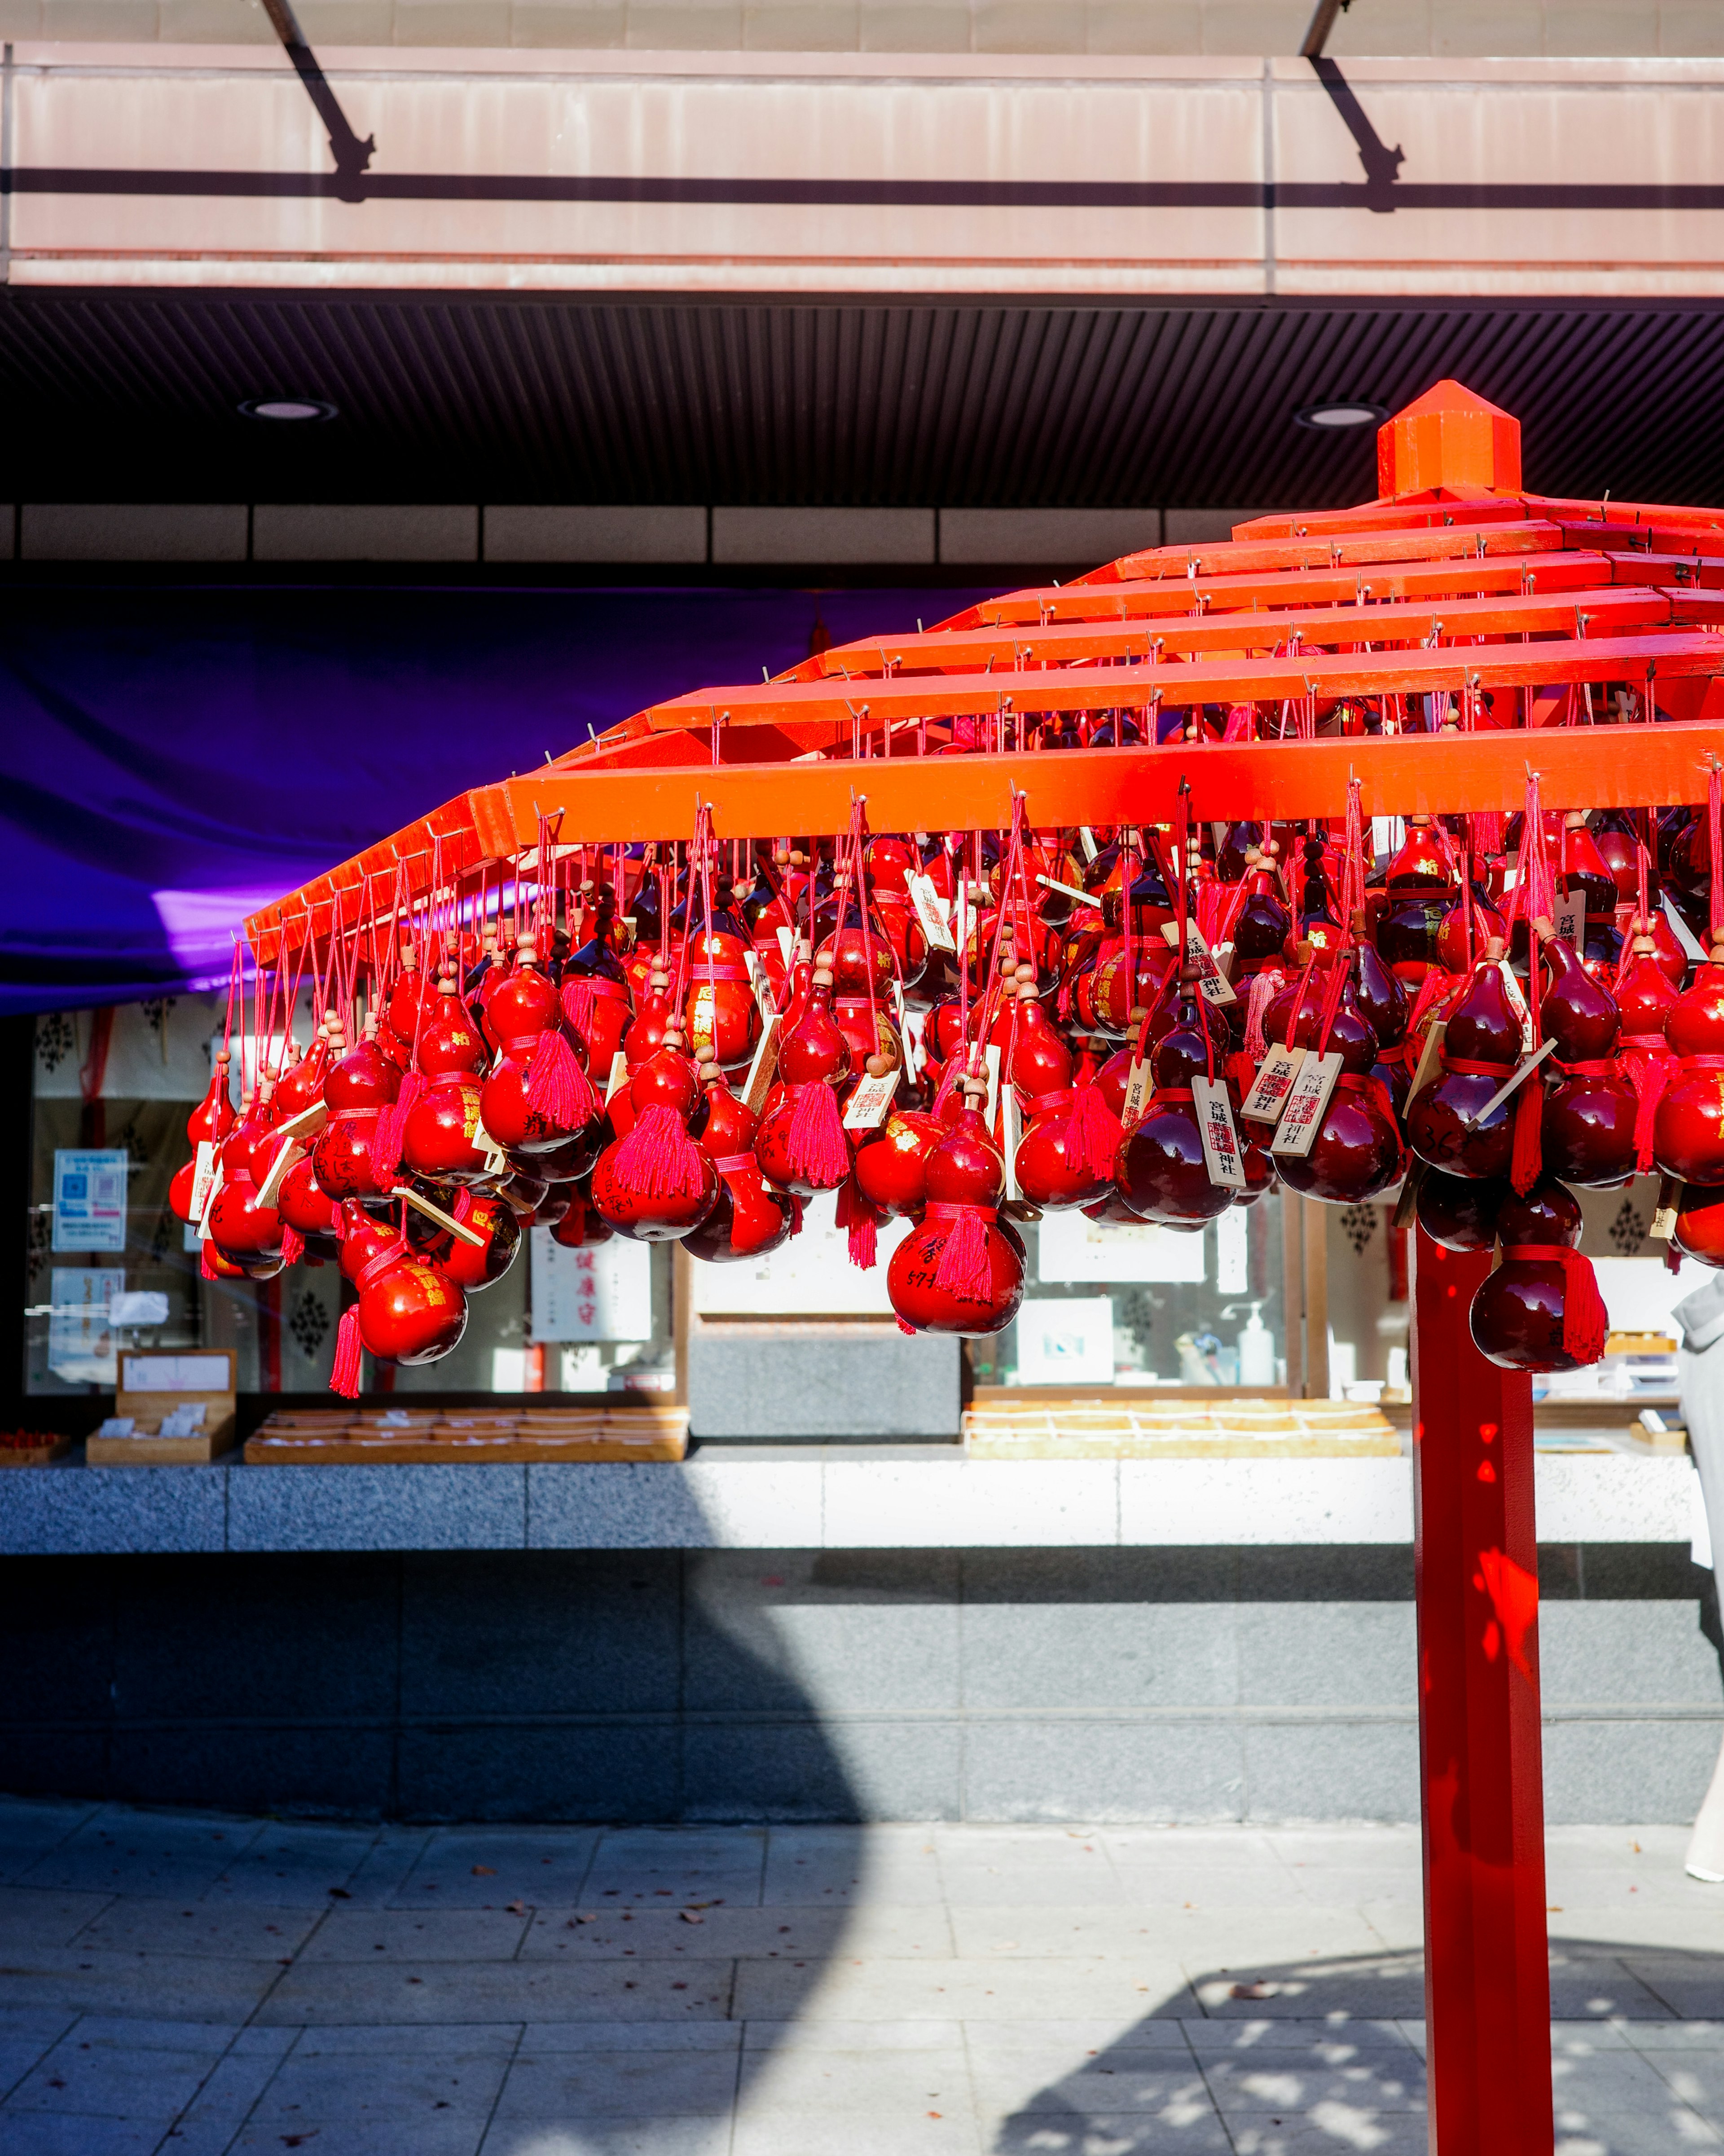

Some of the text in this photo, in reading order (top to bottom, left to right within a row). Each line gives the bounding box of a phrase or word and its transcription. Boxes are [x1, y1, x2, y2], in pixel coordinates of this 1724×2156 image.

[1252, 1060, 1294, 1112] 宮城神社
[1209, 1101, 1237, 1176] 宮城神社
